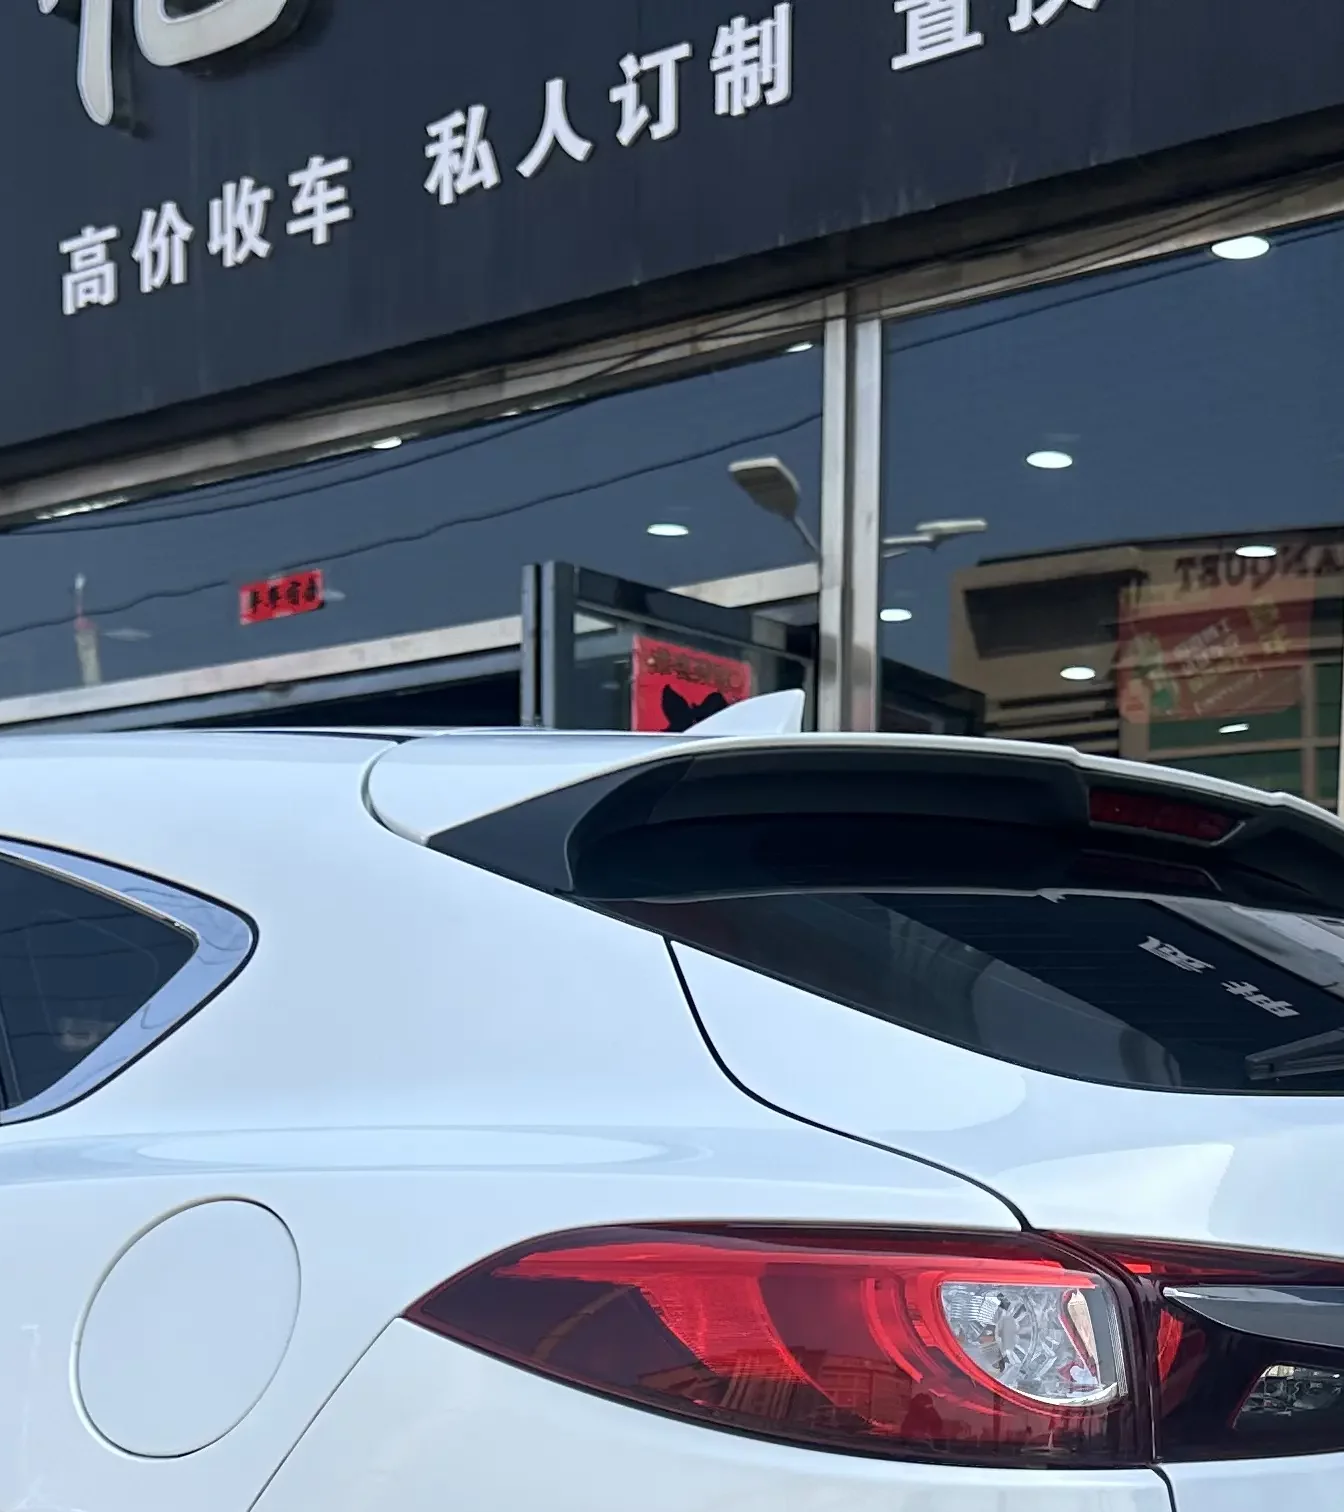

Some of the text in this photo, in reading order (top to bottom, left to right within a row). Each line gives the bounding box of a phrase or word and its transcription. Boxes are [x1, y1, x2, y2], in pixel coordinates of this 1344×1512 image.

[422, 1, 794, 205] 私人订制
[891, 0, 1100, 71] 置
[58, 154, 353, 316] 高价收车
